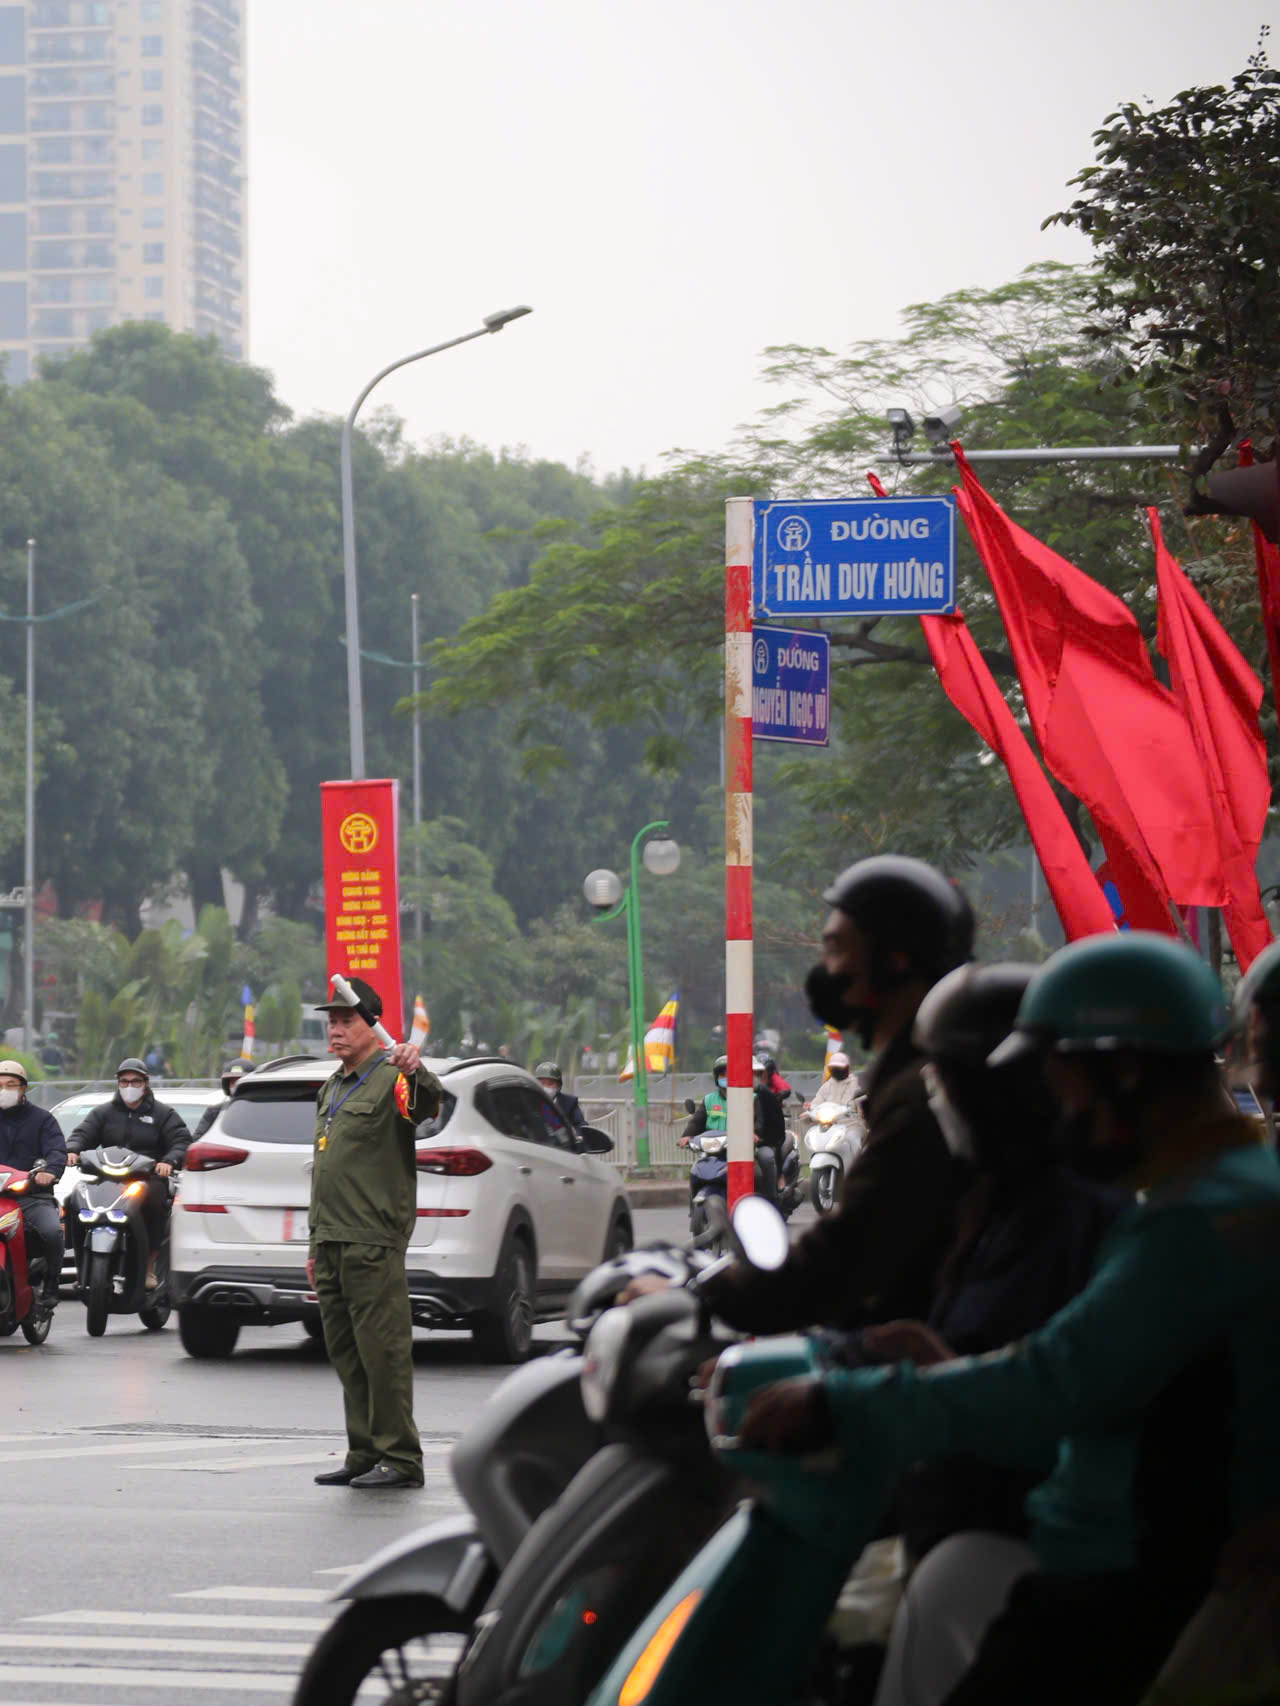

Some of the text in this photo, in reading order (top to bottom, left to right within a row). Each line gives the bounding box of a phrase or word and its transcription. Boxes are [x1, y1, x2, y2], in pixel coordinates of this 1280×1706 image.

[830, 513, 930, 541] ĐƯỜNG
[774, 550, 945, 601] TRẦN DUY HƯNG
[777, 642, 819, 672] ĐƯỜNG
